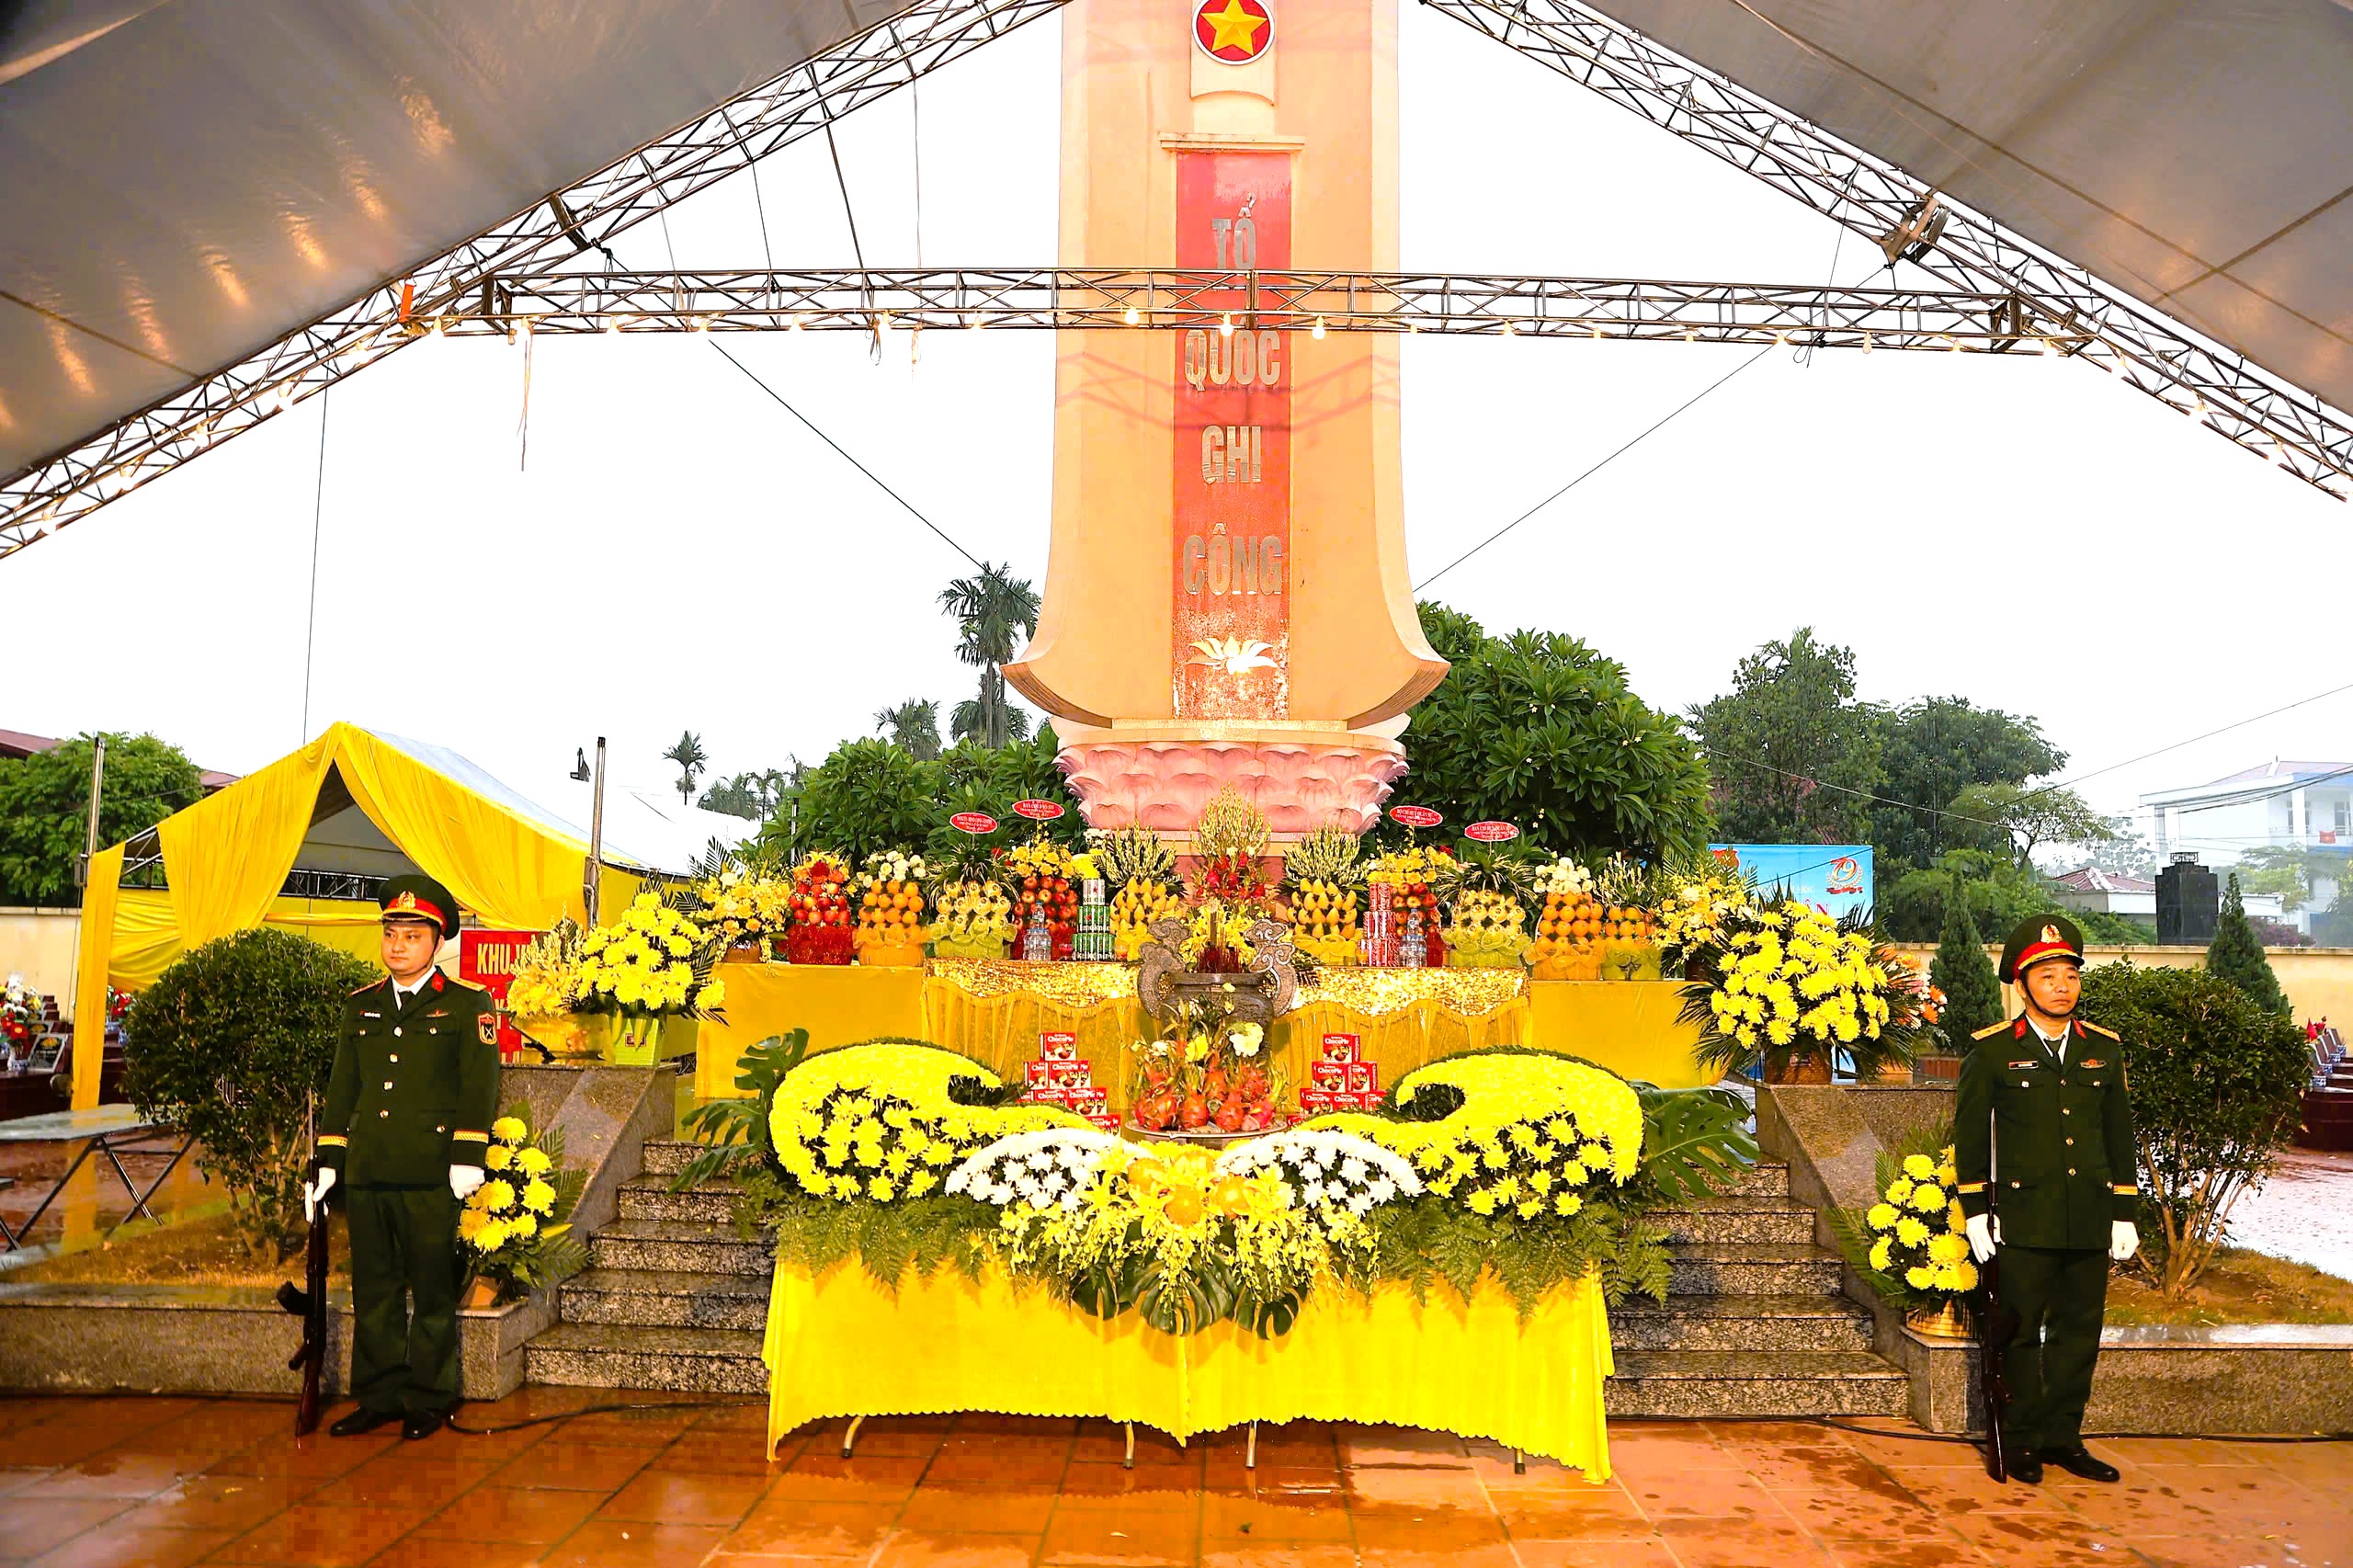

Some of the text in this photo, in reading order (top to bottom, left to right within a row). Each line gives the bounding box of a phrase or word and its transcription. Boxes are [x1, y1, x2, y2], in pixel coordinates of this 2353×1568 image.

[1211, 192, 1256, 269] TỔ
[1202, 425, 1261, 484] GHI
[1183, 522, 1282, 596] CÔNG
[477, 943, 510, 975] KHU
